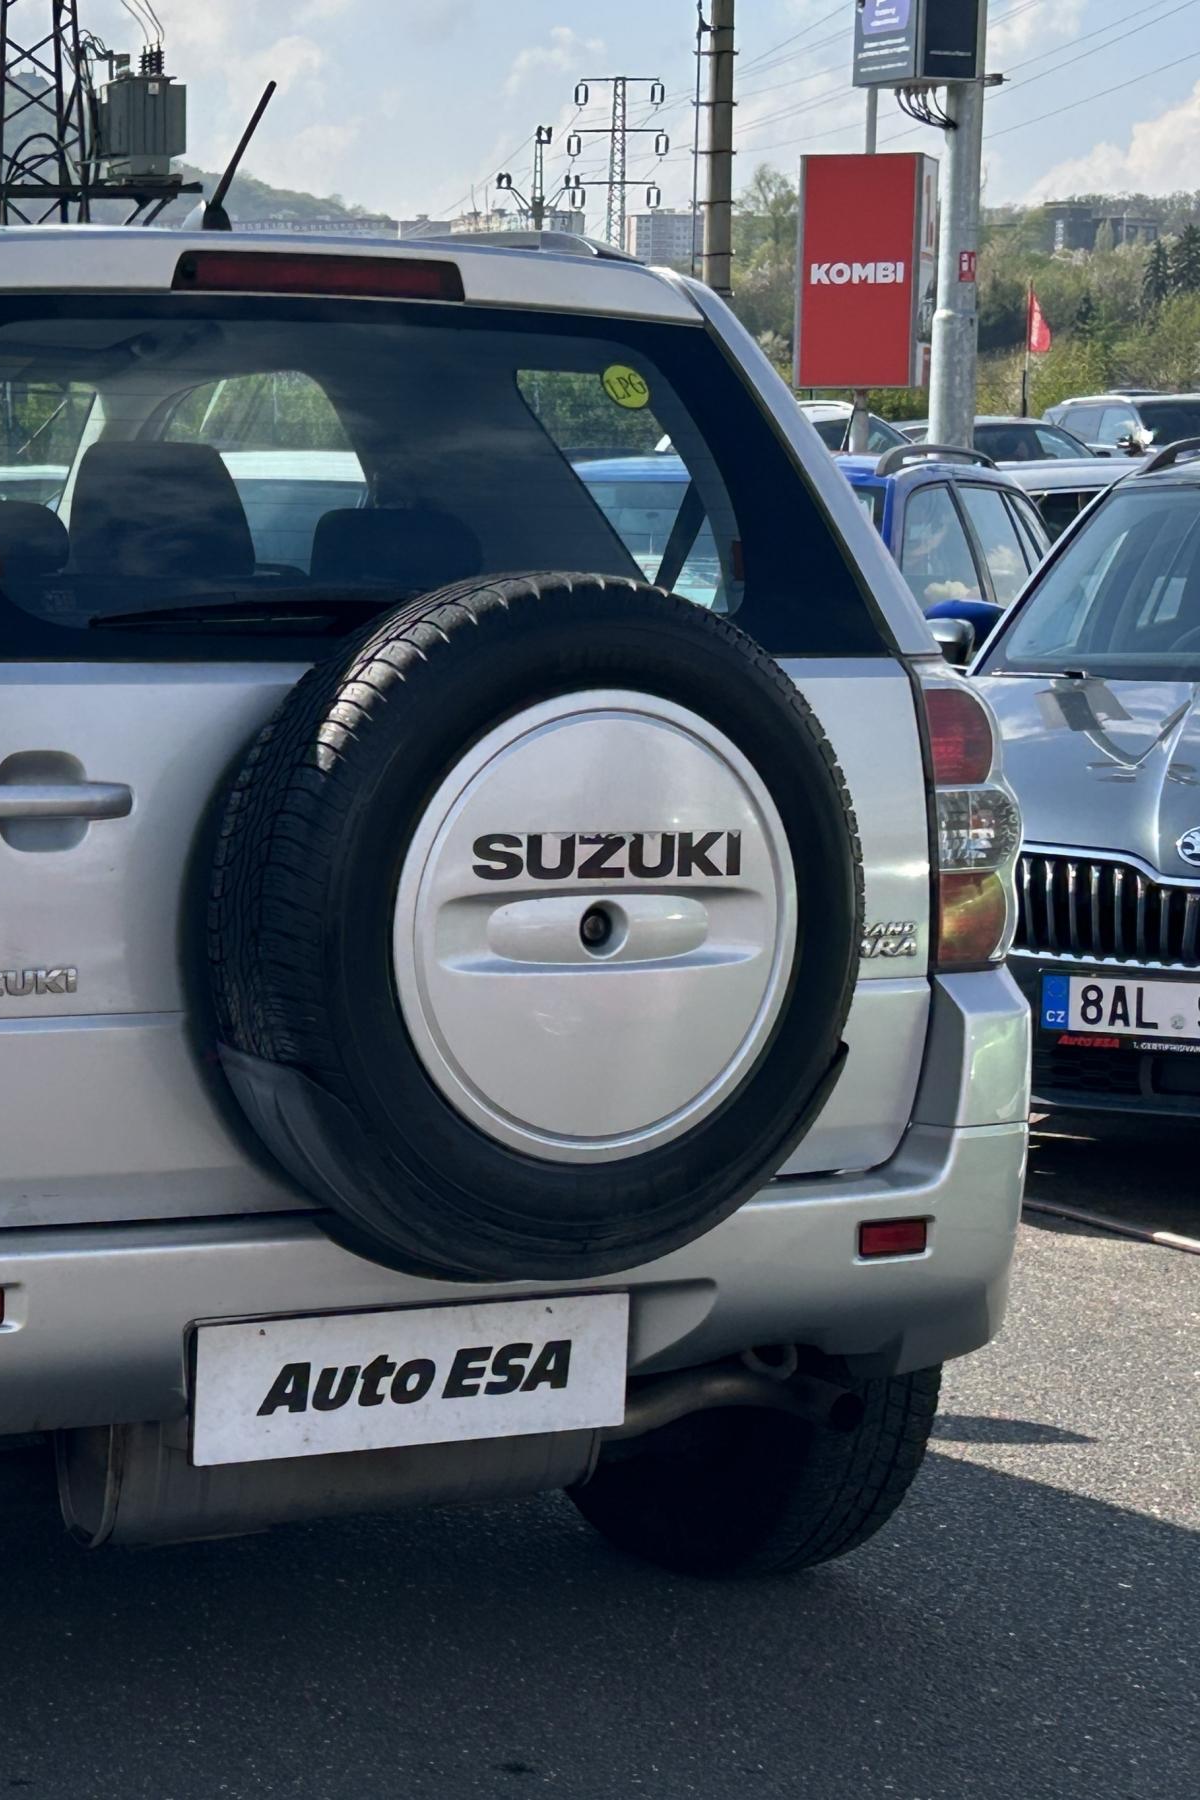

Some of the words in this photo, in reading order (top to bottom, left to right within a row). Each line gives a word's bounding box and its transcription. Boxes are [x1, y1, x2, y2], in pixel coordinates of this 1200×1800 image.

[810, 262, 904, 284] KOMBI
[606, 373, 647, 400] LPG
[472, 831, 741, 880] SUZUKI
[1046, 1010, 1065, 1023] CZ
[1080, 984, 1159, 1030] 8AL
[256, 1355, 436, 1416] Auto
[442, 1339, 572, 1399] ESA
